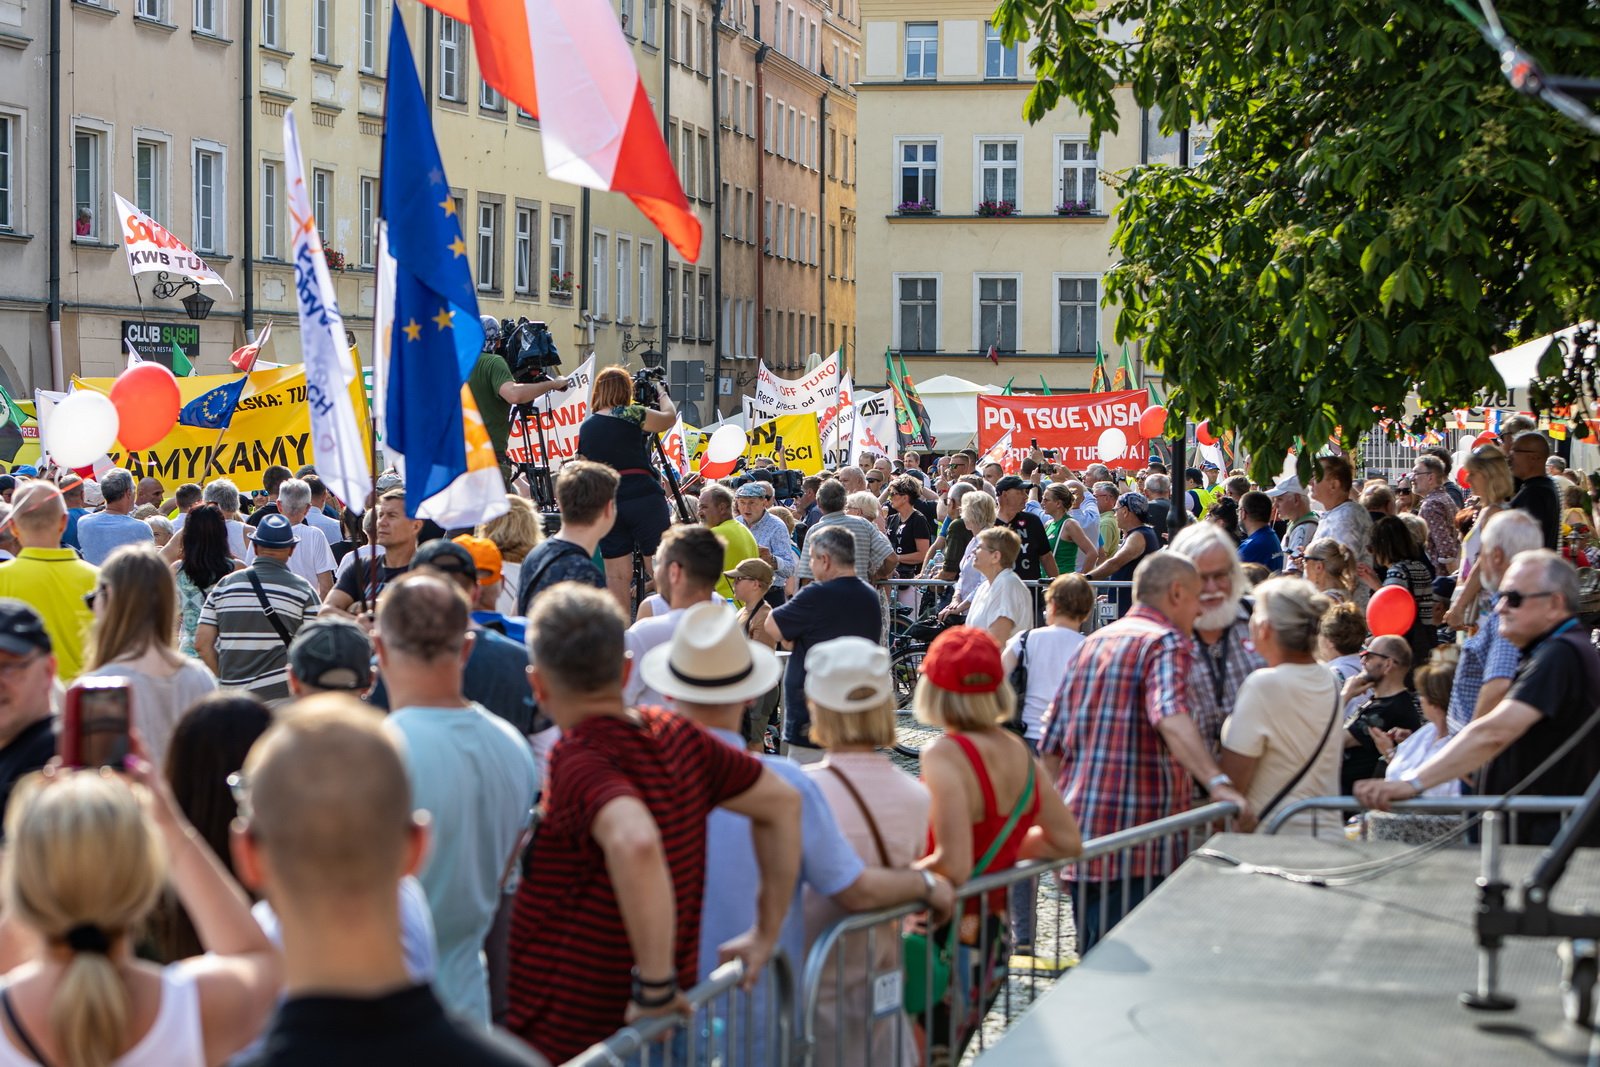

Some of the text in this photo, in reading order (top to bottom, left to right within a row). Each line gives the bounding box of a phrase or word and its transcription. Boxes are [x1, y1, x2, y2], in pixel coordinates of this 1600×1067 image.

[130, 251, 170, 266] KWB
[128, 325, 198, 345] CLUB SUSHI
[780, 386, 797, 397] OFF
[801, 362, 837, 391] TURO
[286, 385, 309, 404] TU
[757, 390, 775, 405] Ręce
[801, 396, 815, 408] od
[984, 402, 1141, 433] PO, TSUE, WSA
